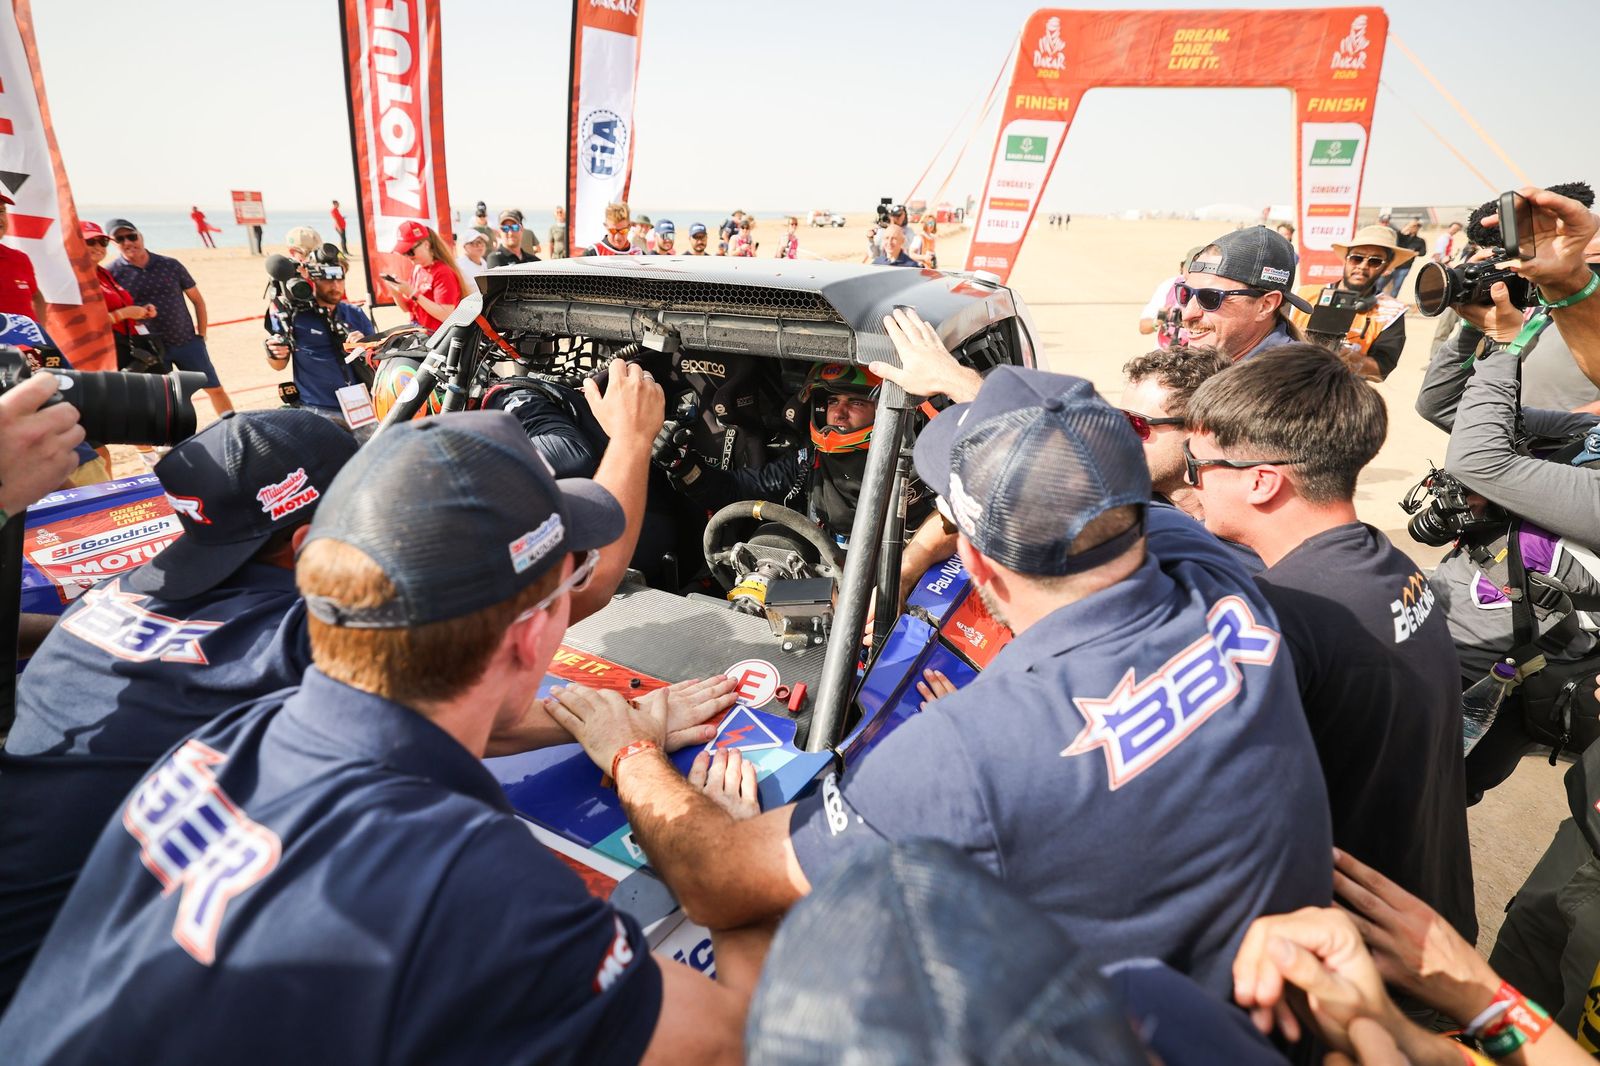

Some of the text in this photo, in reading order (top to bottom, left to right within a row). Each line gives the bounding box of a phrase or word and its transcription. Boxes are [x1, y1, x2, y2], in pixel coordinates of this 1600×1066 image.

[1173, 28, 1231, 43] DREAM.
[1170, 42, 1214, 56] DARE.
[1032, 50, 1066, 70] DAKAR
[1167, 56, 1220, 70] LIVE IT.
[1330, 50, 1367, 70] DAKAR
[373, 0, 422, 211] MOTUL
[1015, 95, 1070, 112] FINISH
[1307, 97, 1367, 113] FINISH
[681, 359, 726, 378] sparco
[106, 480, 137, 491] Jan
[109, 501, 157, 517] DREAM.
[272, 489, 318, 517] MOTUL
[112, 510, 149, 521] DARE.
[116, 516, 145, 526] LIVE
[51, 521, 170, 559] BFGoodrich
[926, 573, 951, 595] Pau
[578, 660, 611, 676] IT.
[735, 669, 767, 700] E
[1080, 602, 1279, 780] BBR
